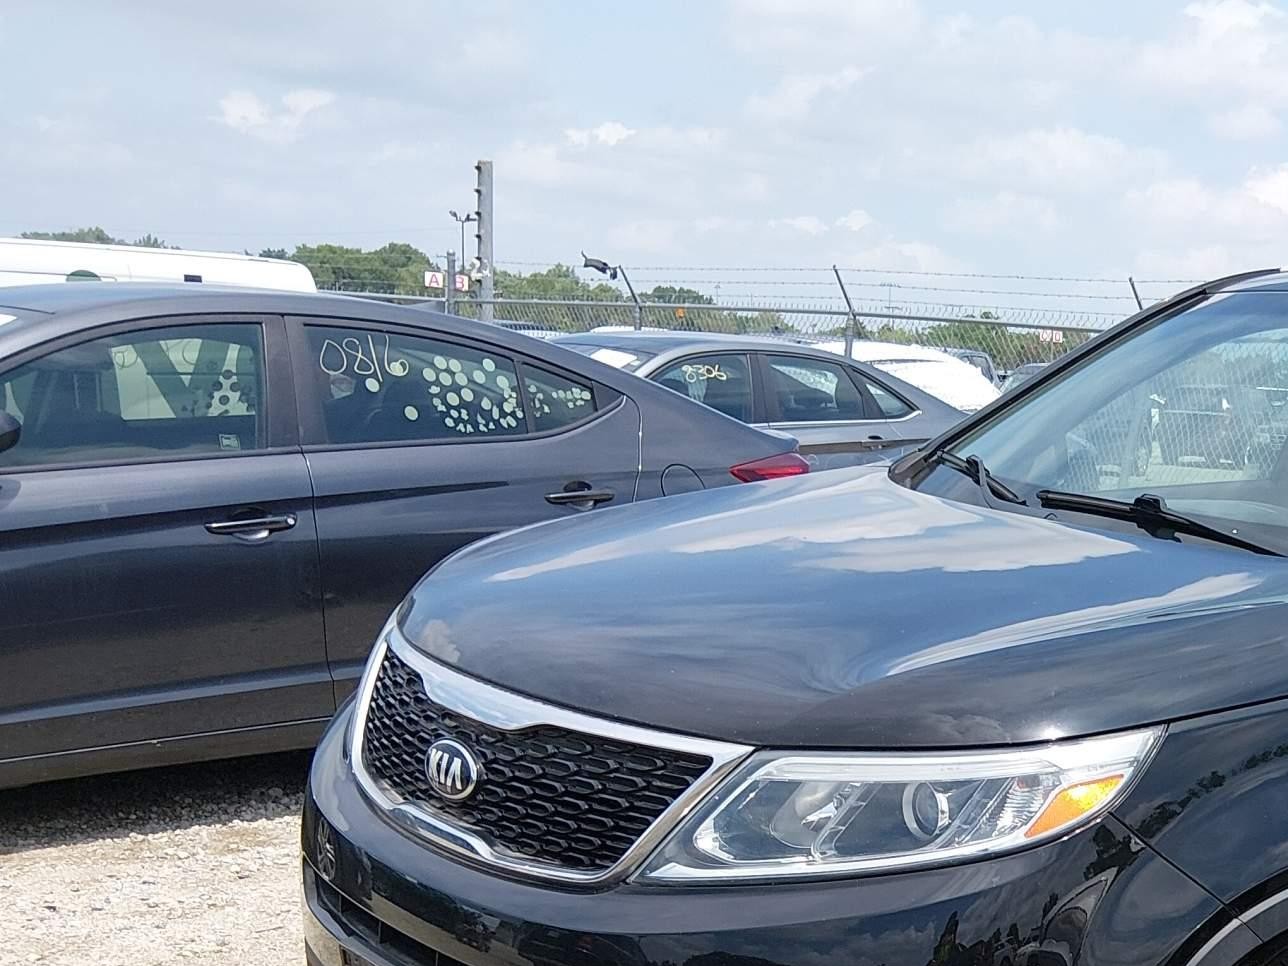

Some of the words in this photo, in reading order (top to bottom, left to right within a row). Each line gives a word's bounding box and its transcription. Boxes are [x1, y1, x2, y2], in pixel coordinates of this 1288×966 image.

[428, 273, 440, 287] A
[320, 334, 409, 383] 0816
[681, 363, 727, 383] 8306
